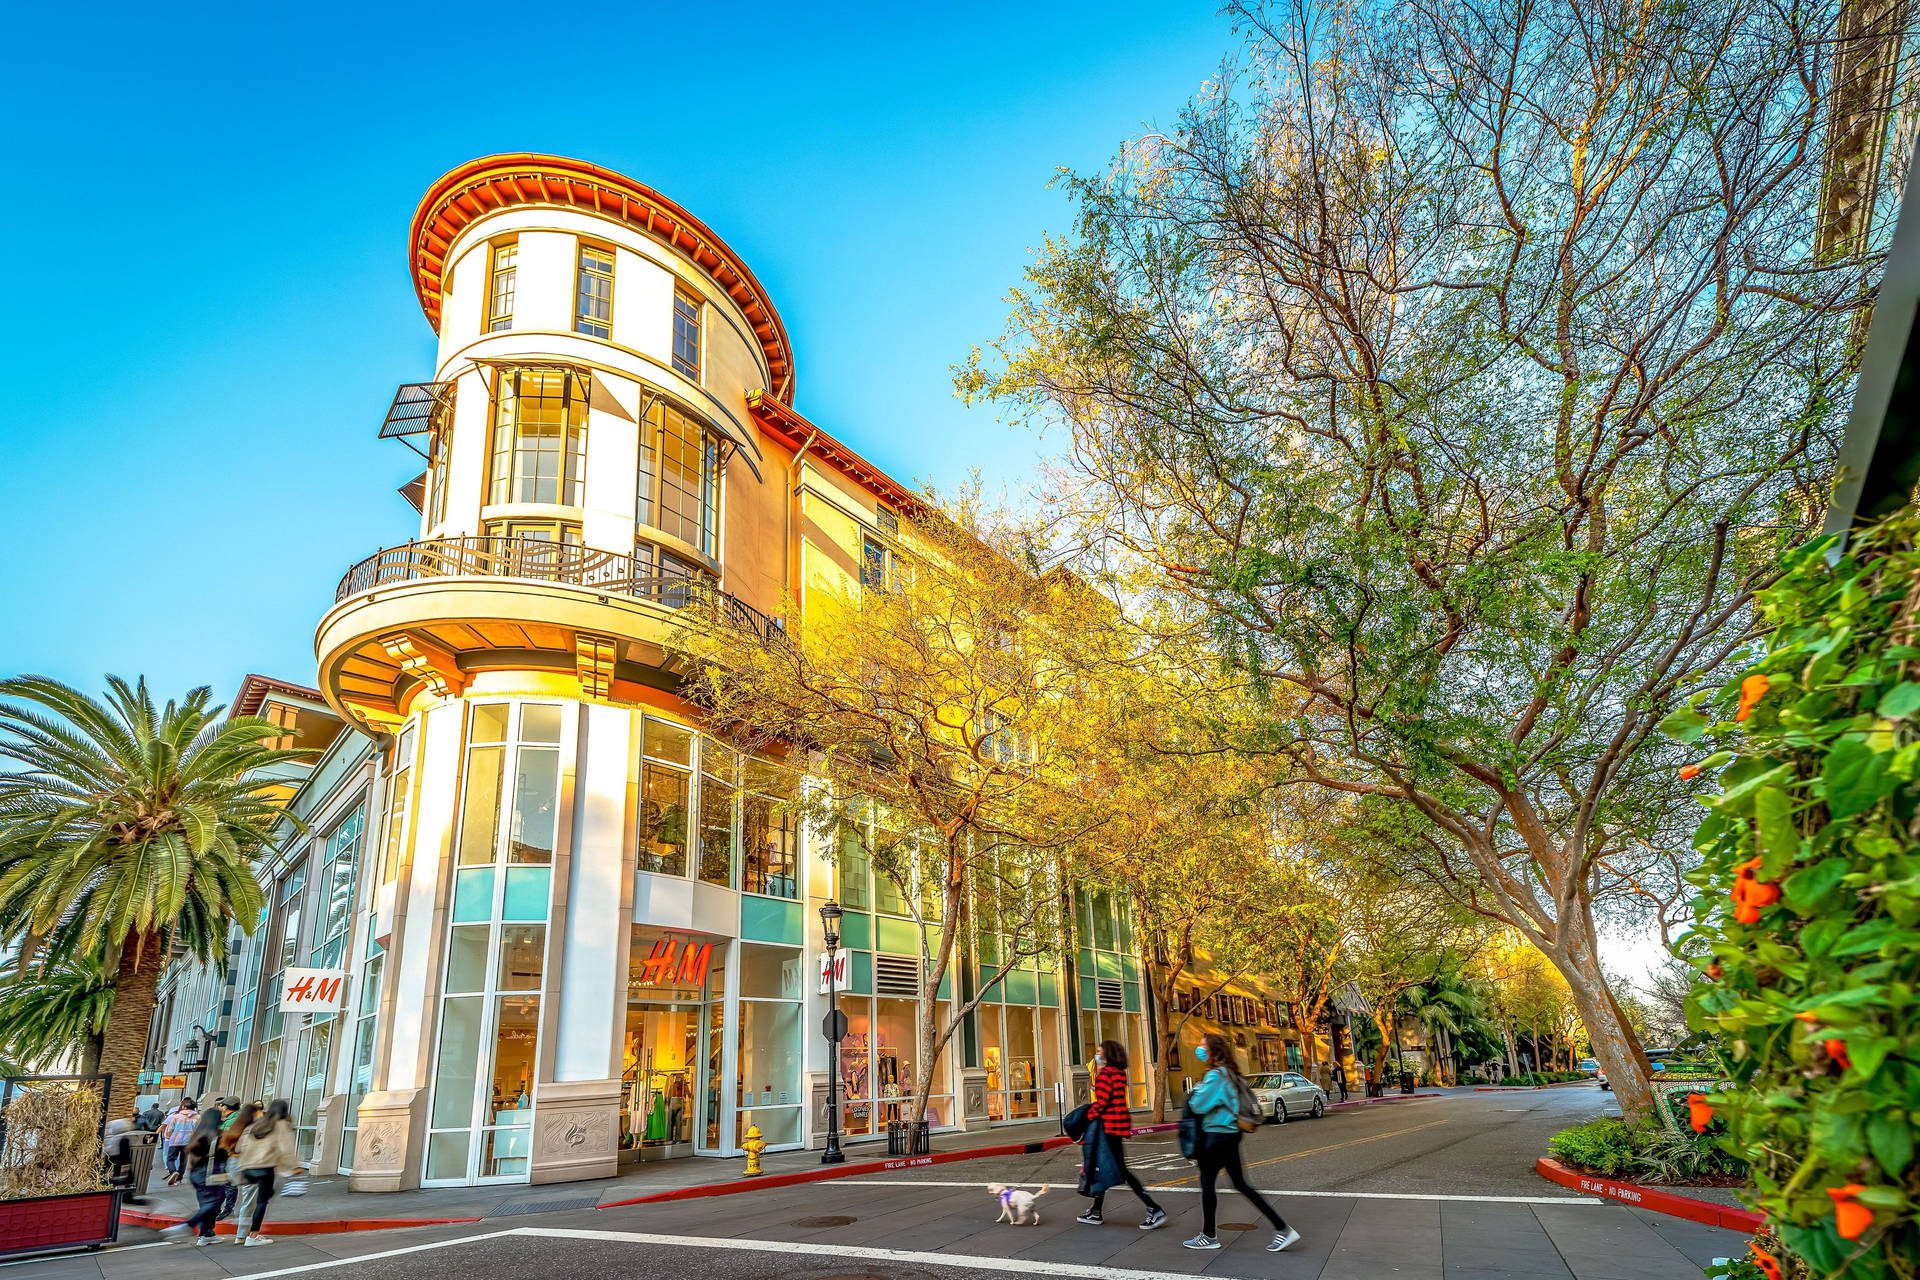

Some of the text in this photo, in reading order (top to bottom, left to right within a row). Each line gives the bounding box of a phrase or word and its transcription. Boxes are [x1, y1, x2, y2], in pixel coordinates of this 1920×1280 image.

[641, 939, 712, 989] H&M
[822, 957, 845, 984] HM
[287, 976, 341, 1003] H&M
[1581, 1180, 1590, 1190] FIRE
[1591, 1183, 1603, 1193] LANE
[1609, 1186, 1616, 1196] NO
[1617, 1188, 1641, 1202] PARKING
